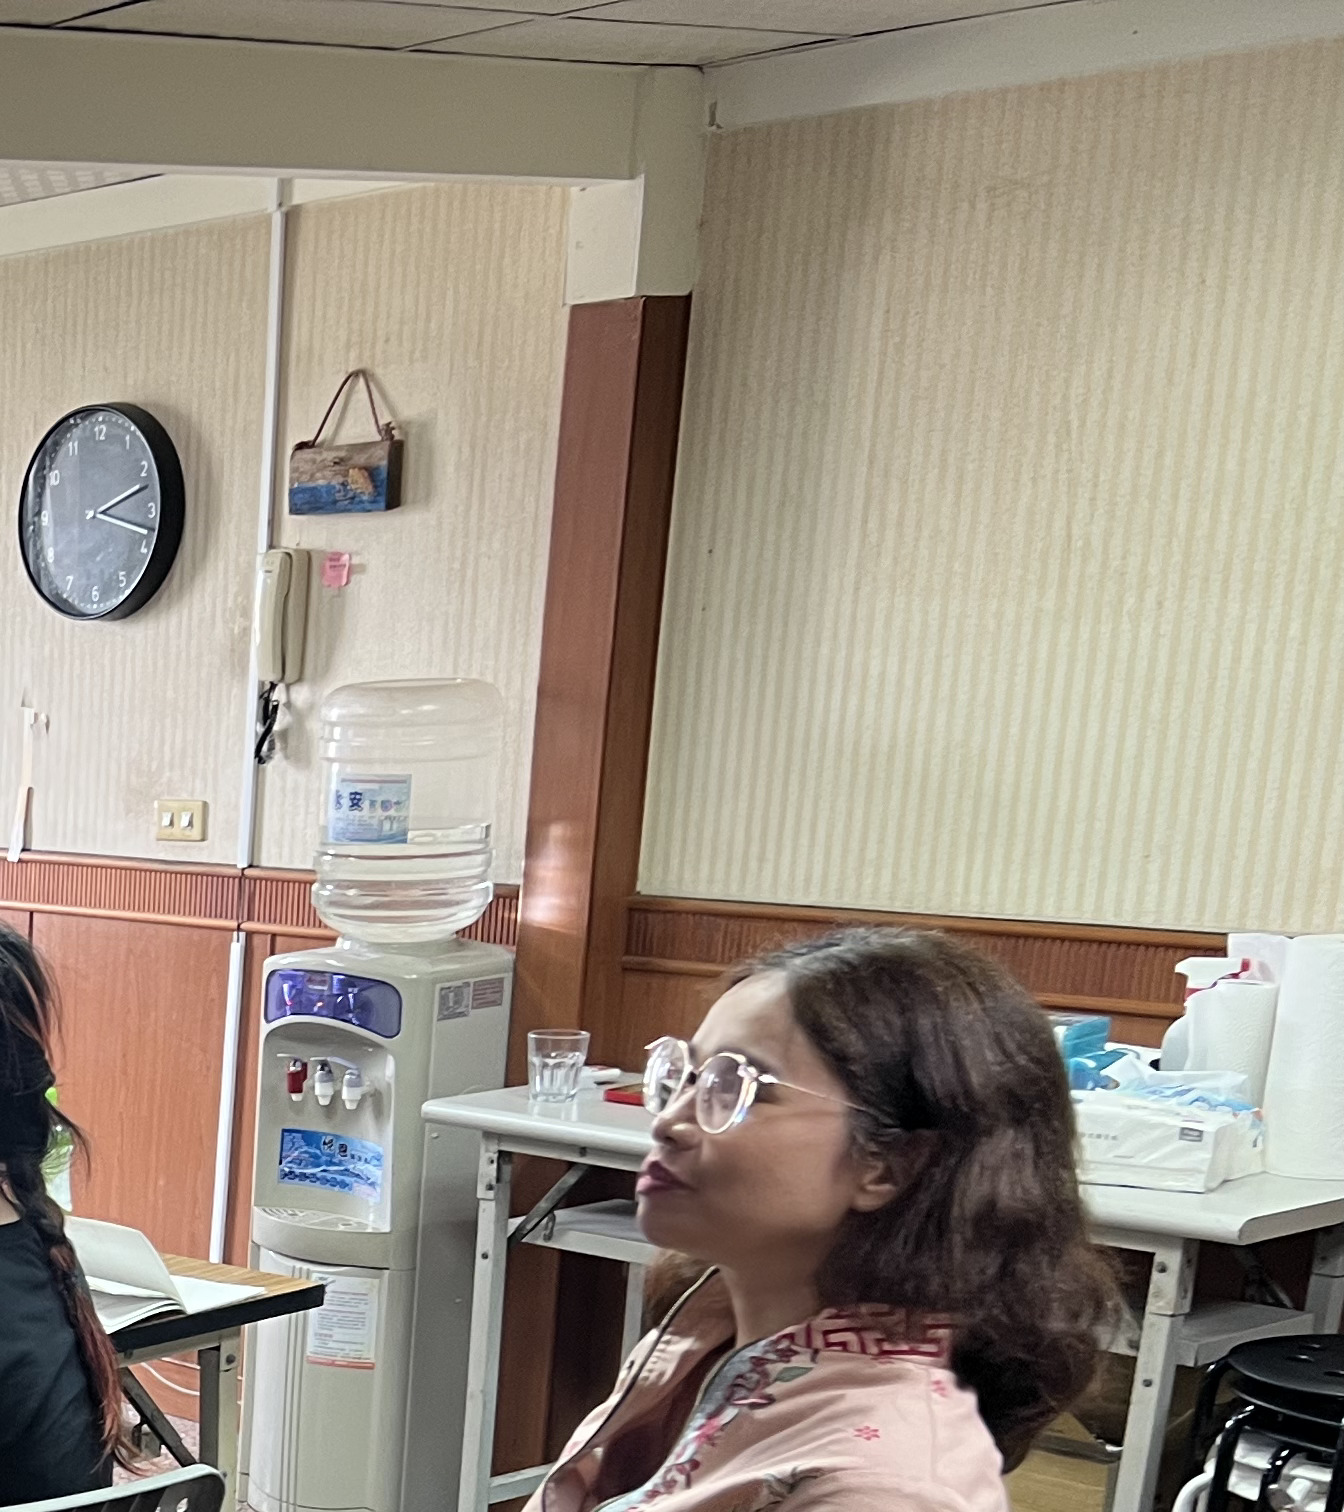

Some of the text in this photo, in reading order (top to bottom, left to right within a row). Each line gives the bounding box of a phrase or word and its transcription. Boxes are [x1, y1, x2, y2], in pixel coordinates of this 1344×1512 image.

[94, 425, 107, 441] 12
[68, 440, 79, 456] 11
[124, 434, 131, 450] 1
[140, 461, 149, 477] 2
[49, 470, 60, 486] 10
[41, 510, 49, 526] 9
[147, 502, 156, 519] 3
[140, 539, 148, 554] 4
[46, 547, 54, 563] 8
[65, 575, 74, 591] 7
[118, 571, 127, 588] 5
[91, 585, 100, 602] 6
